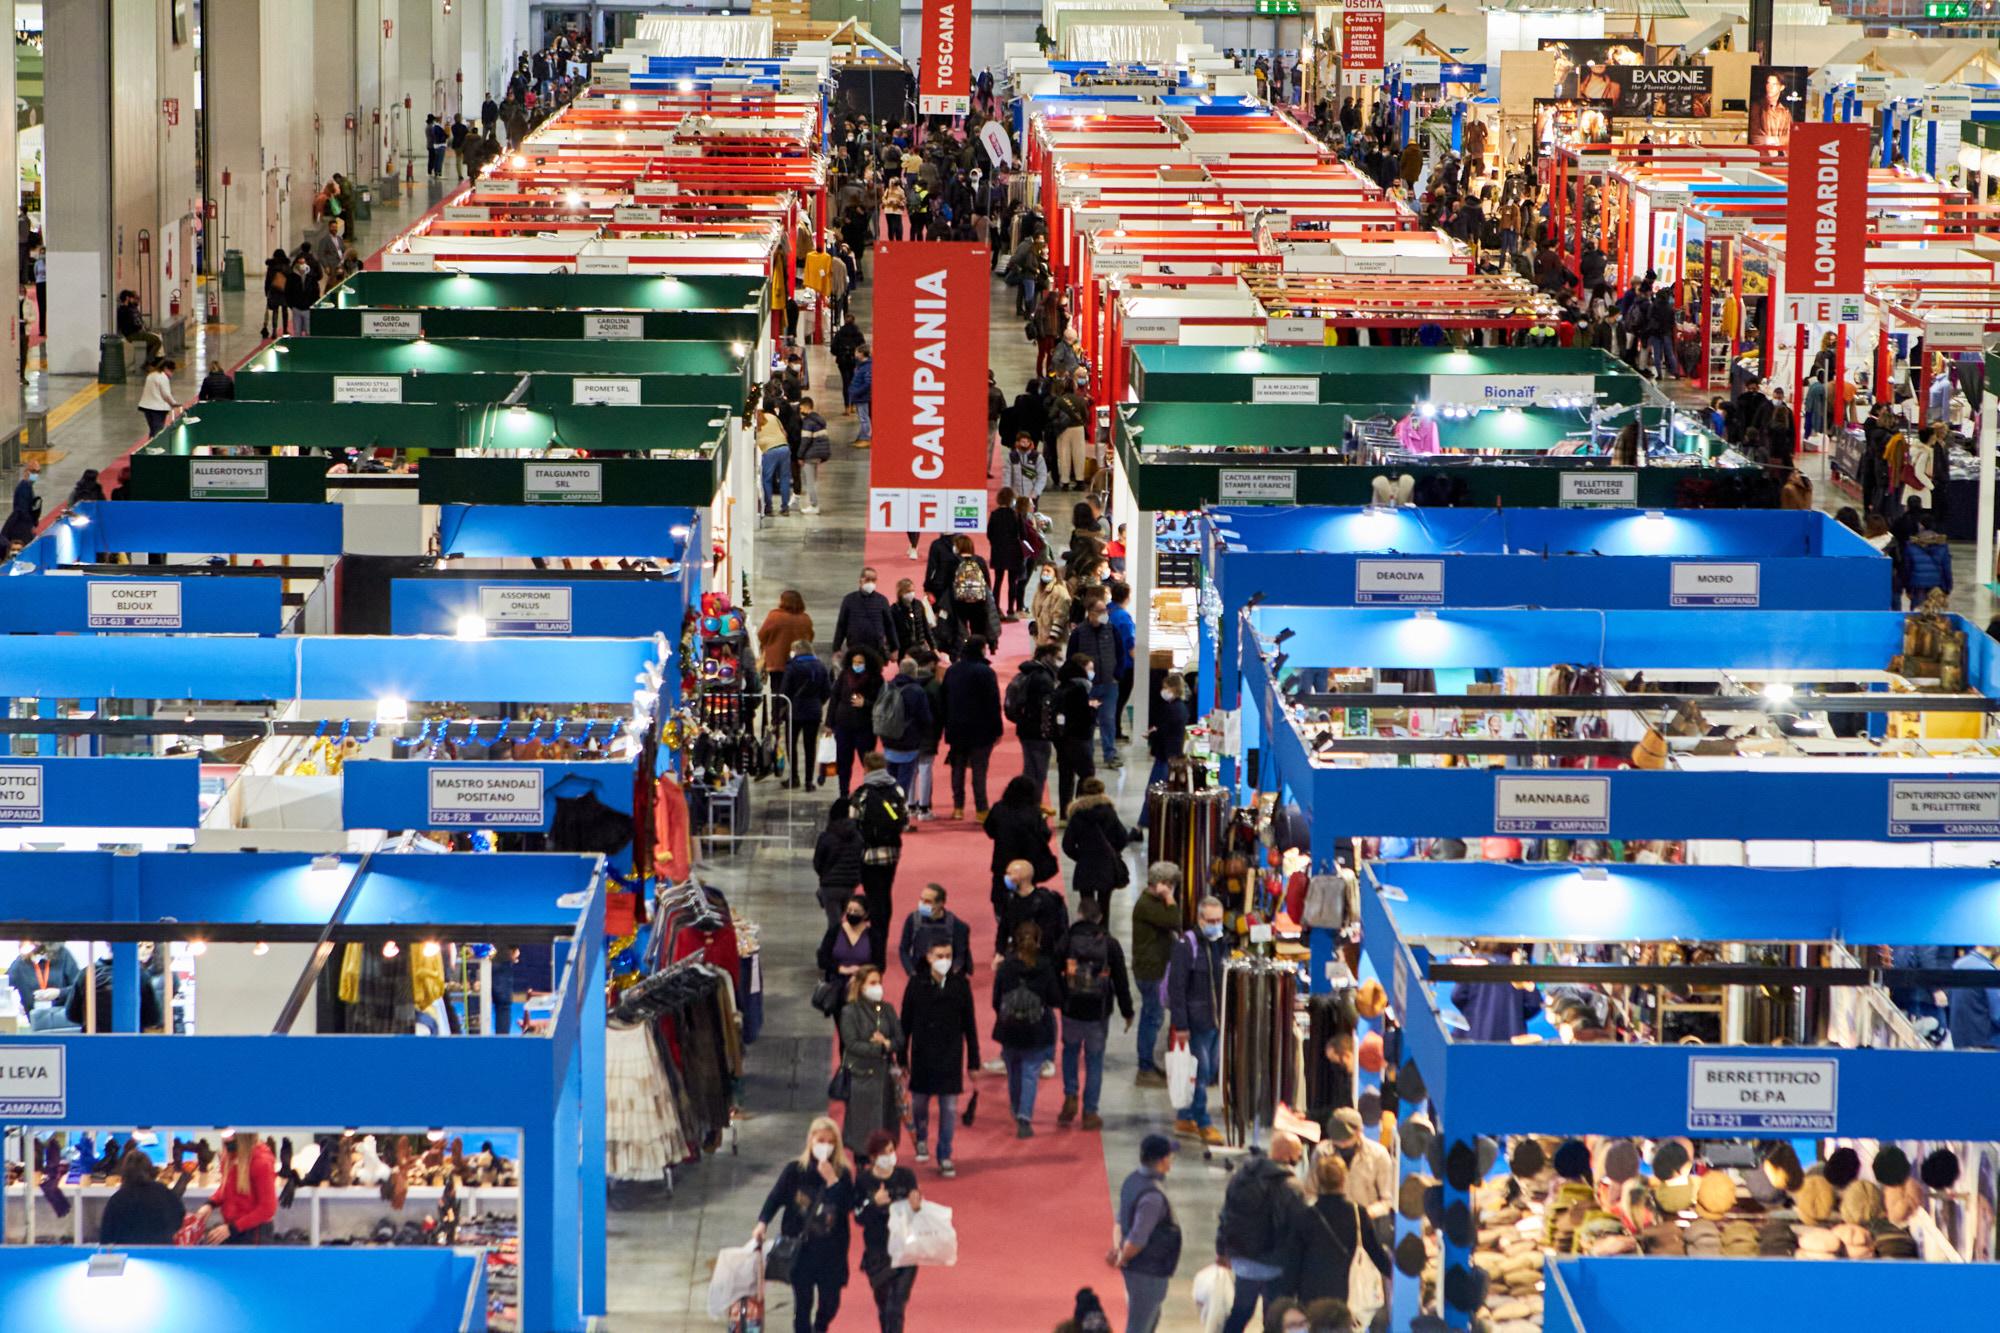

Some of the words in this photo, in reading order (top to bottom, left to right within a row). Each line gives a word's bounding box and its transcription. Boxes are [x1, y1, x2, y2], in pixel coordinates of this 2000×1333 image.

[1346, 0, 1383, 8] USCITA
[938, 4, 954, 88] TOSCANA
[1345, 74, 1350, 83] 1
[1360, 74, 1366, 83] E
[1632, 70, 1704, 84] BARONE
[924, 100, 929, 112] 1
[940, 100, 949, 112] F
[1814, 140, 1840, 287] LOMBARDIA
[1790, 302, 1798, 320] 1
[1818, 302, 1831, 321] E
[912, 269, 947, 480] CAMPANIA
[1485, 386, 1536, 398] Bionaïf
[880, 501, 892, 527] 1
[918, 502, 937, 528] F
[1377, 572, 1424, 580] DEAOLIVA
[111, 590, 157, 598] CONCEPT
[117, 602, 153, 611] BIJOUX
[436, 779, 484, 788] MASTRO
[487, 779, 536, 788] SANDALI
[457, 792, 515, 802] POSITANO
[1515, 794, 1590, 804] MANNABAG
[1896, 792, 1962, 800] CINTURIFICIO
[1964, 792, 1997, 800] GENNY
[1912, 803, 1920, 812] IL
[1922, 803, 1981, 812] PELLETTIERE
[433, 813, 471, 821] F26-F28
[484, 813, 540, 821] CAMPANIA
[1499, 821, 1537, 830] F25-F27
[1550, 821, 1606, 830] CAMPANIA
[1893, 824, 1910, 833] E26
[1944, 824, 1999, 833] CAMPANIA
[9, 1067, 48, 1078] LEVA
[1707, 1071, 1820, 1084] BERRETTIFICIO
[1740, 1090, 1786, 1102] DE.PA
[1694, 1114, 1742, 1126] F19-F21
[1760, 1114, 1833, 1126] CAMPANIA
